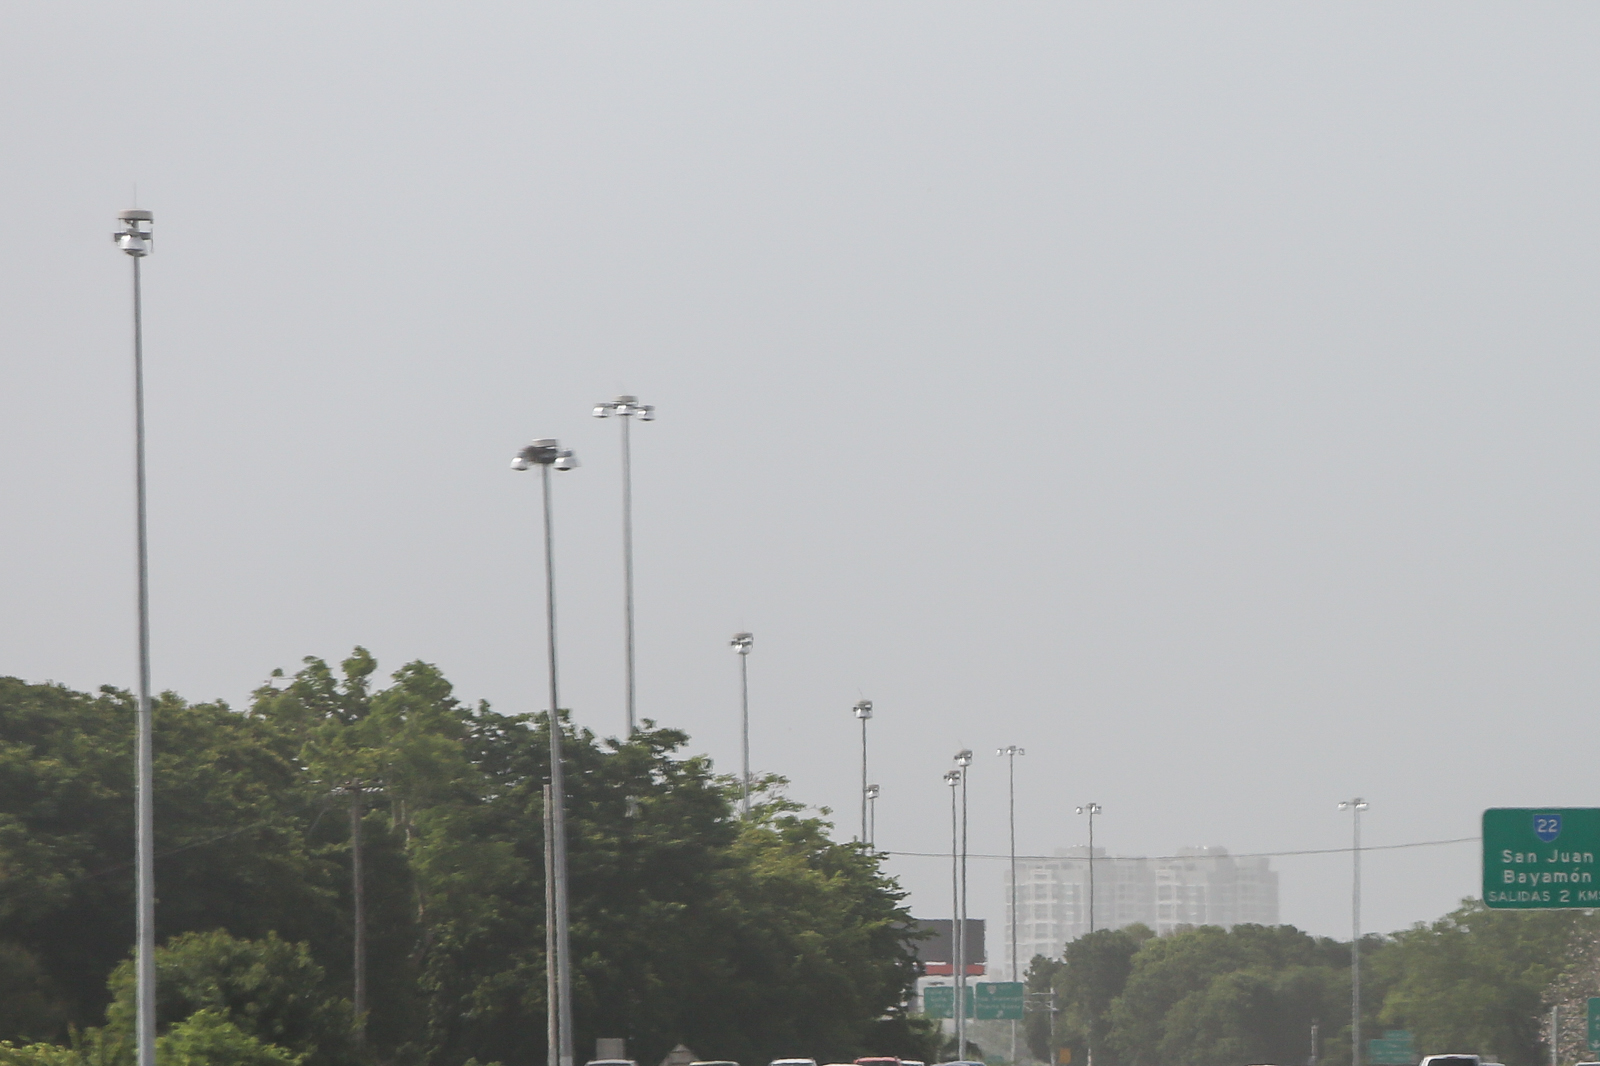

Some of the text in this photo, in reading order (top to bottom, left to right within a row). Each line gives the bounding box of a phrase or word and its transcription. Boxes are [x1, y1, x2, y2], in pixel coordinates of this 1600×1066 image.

[1537, 818, 1558, 833] 22
[1502, 849, 1594, 863] San Juan
[1503, 867, 1592, 887] Bayamón
[1488, 890, 1550, 902] SALIDAS
[1559, 889, 1571, 903] 2
